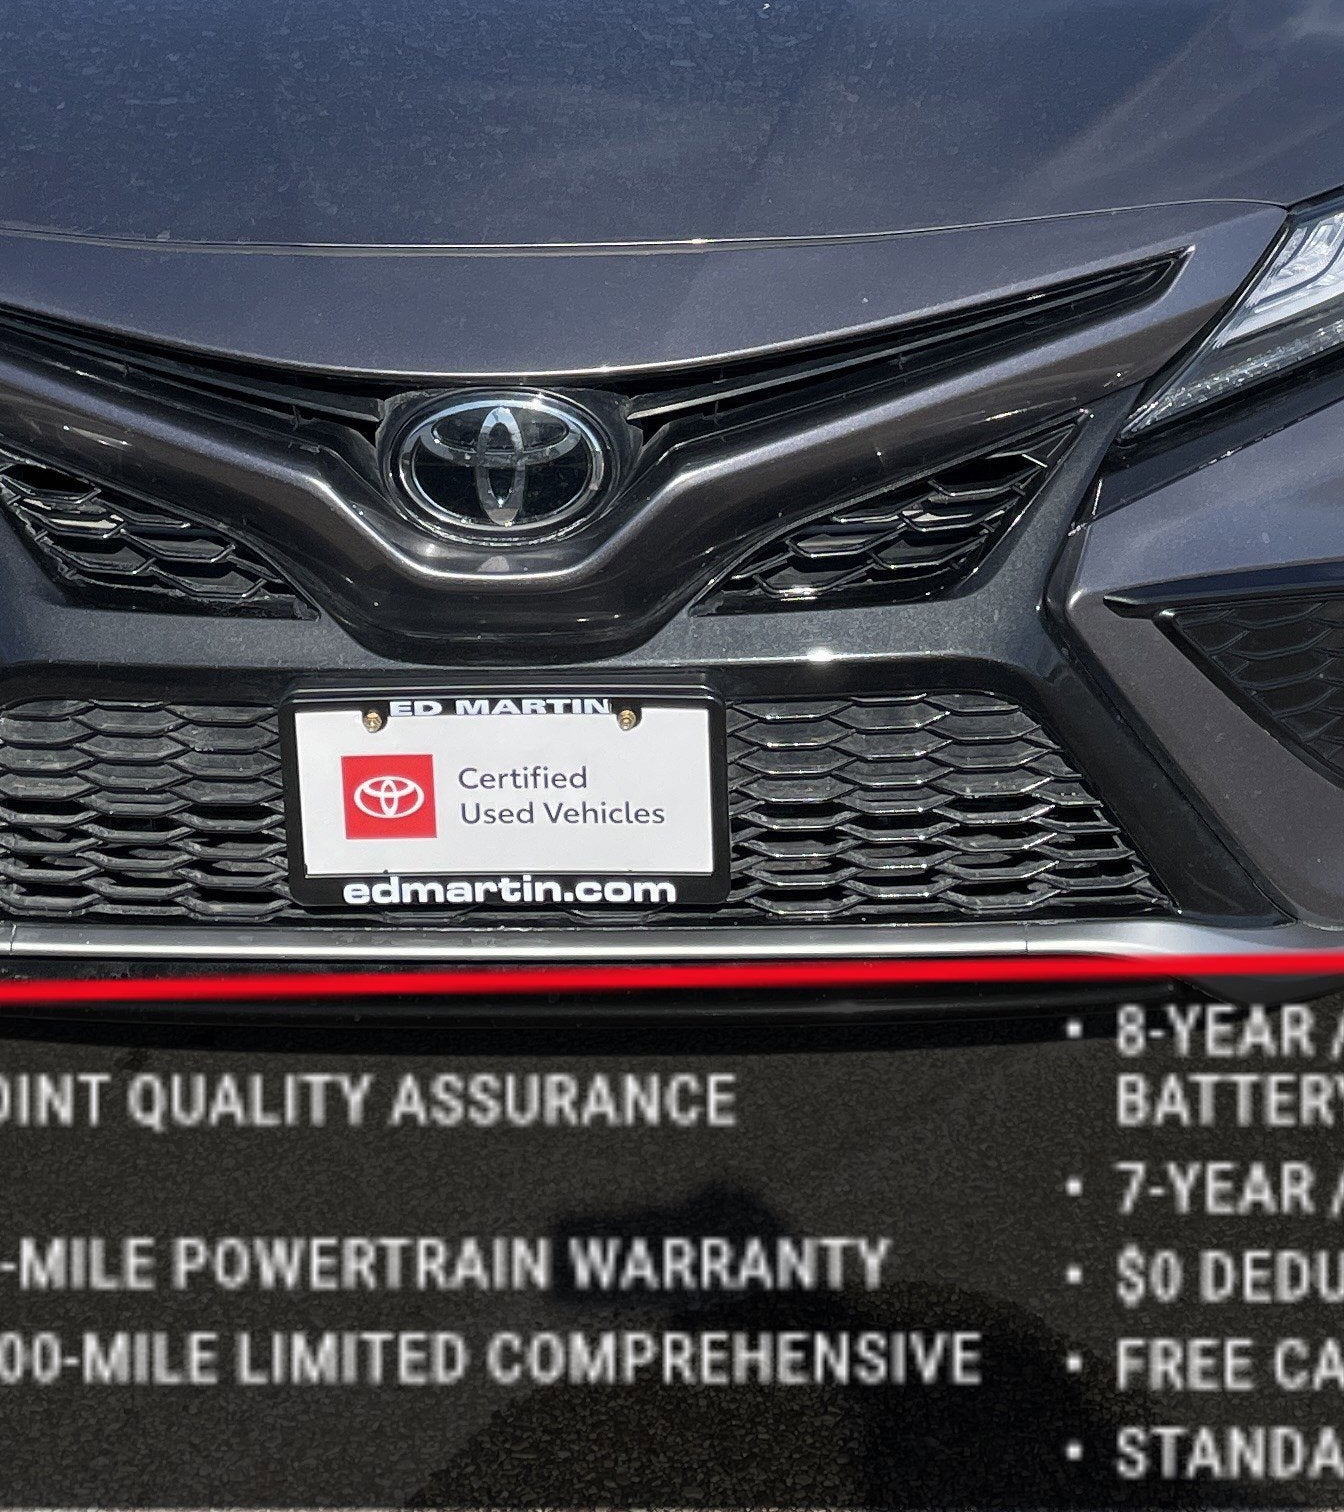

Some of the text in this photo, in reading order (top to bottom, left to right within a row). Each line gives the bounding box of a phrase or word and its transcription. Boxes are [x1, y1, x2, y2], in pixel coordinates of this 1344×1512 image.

[389, 697, 612, 718] ED MARTIN
[458, 766, 588, 789] Certified
[461, 801, 666, 825] Used Vehicles
[342, 875, 677, 905] edmartin.com
